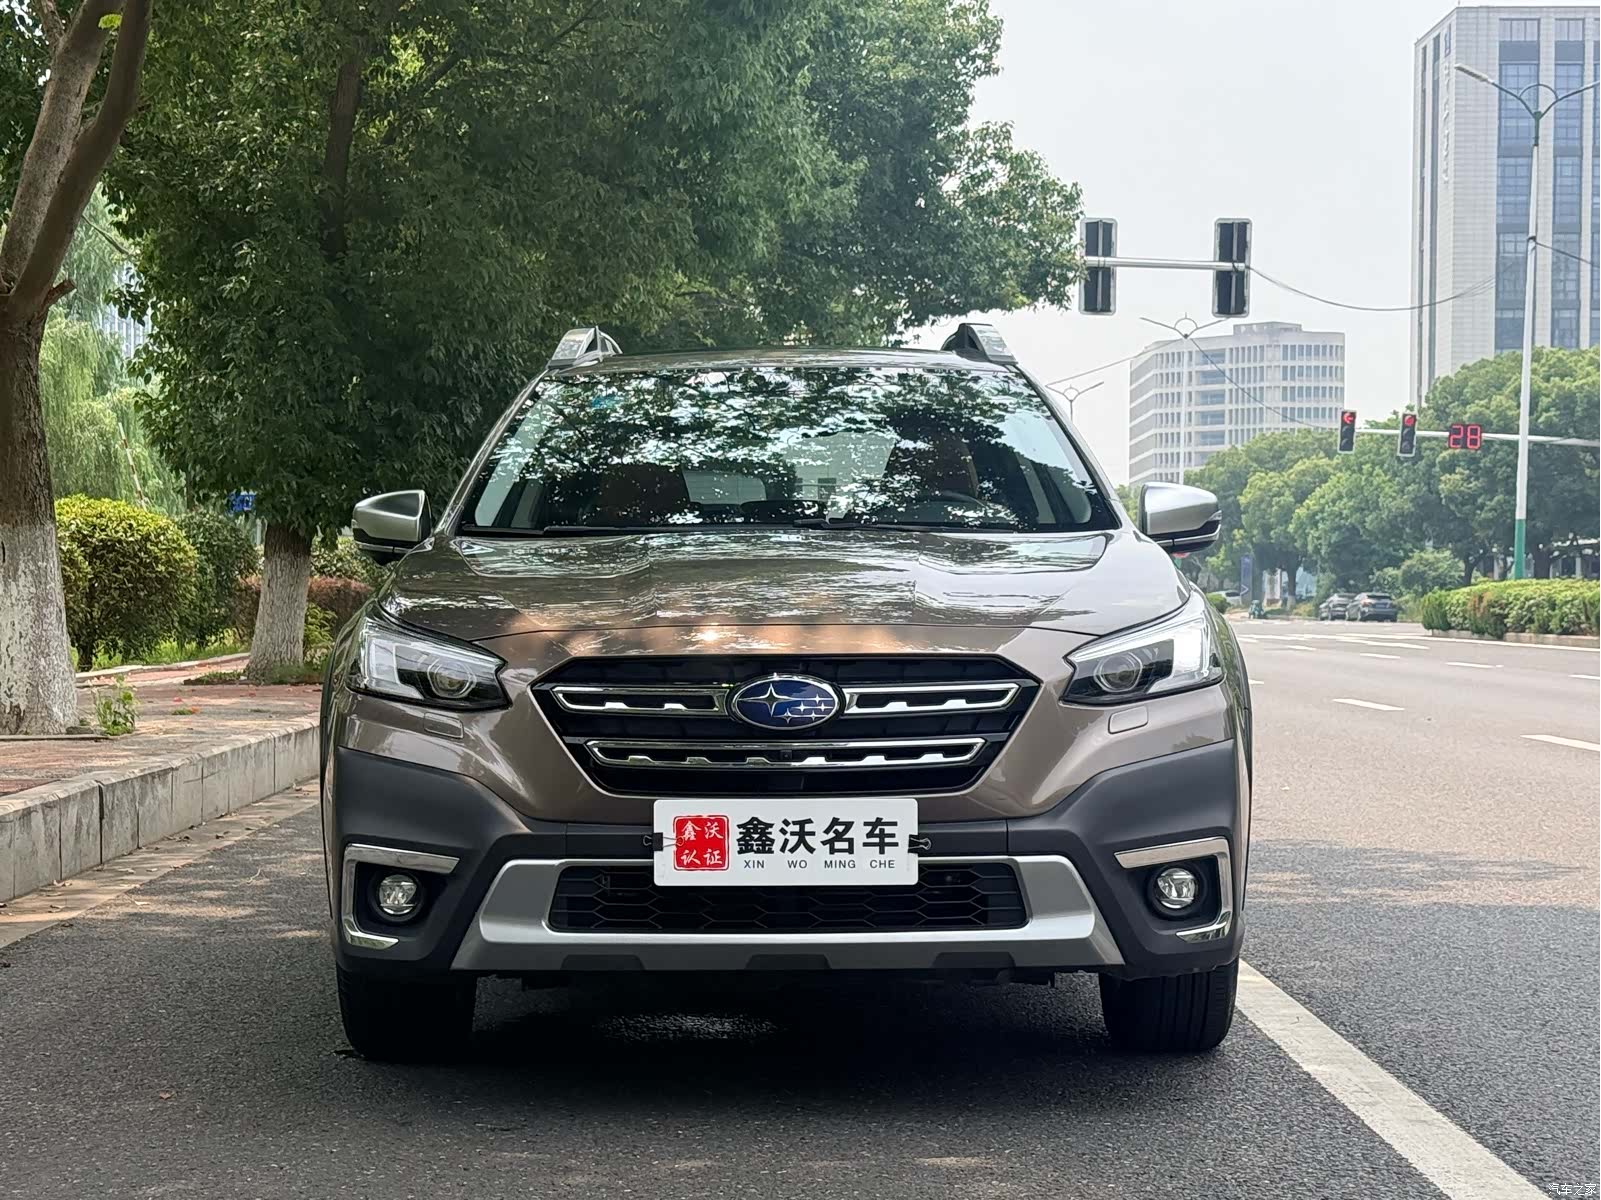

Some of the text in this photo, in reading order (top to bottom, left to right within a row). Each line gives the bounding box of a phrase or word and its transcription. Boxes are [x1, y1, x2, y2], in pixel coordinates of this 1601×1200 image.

[1449, 424, 1481, 449] 28
[681, 820, 724, 841] 鑫沃
[736, 816, 900, 855] 鑫沃名车
[680, 848, 723, 866] 认证
[744, 859, 896, 869] XIN WO MING CHE
